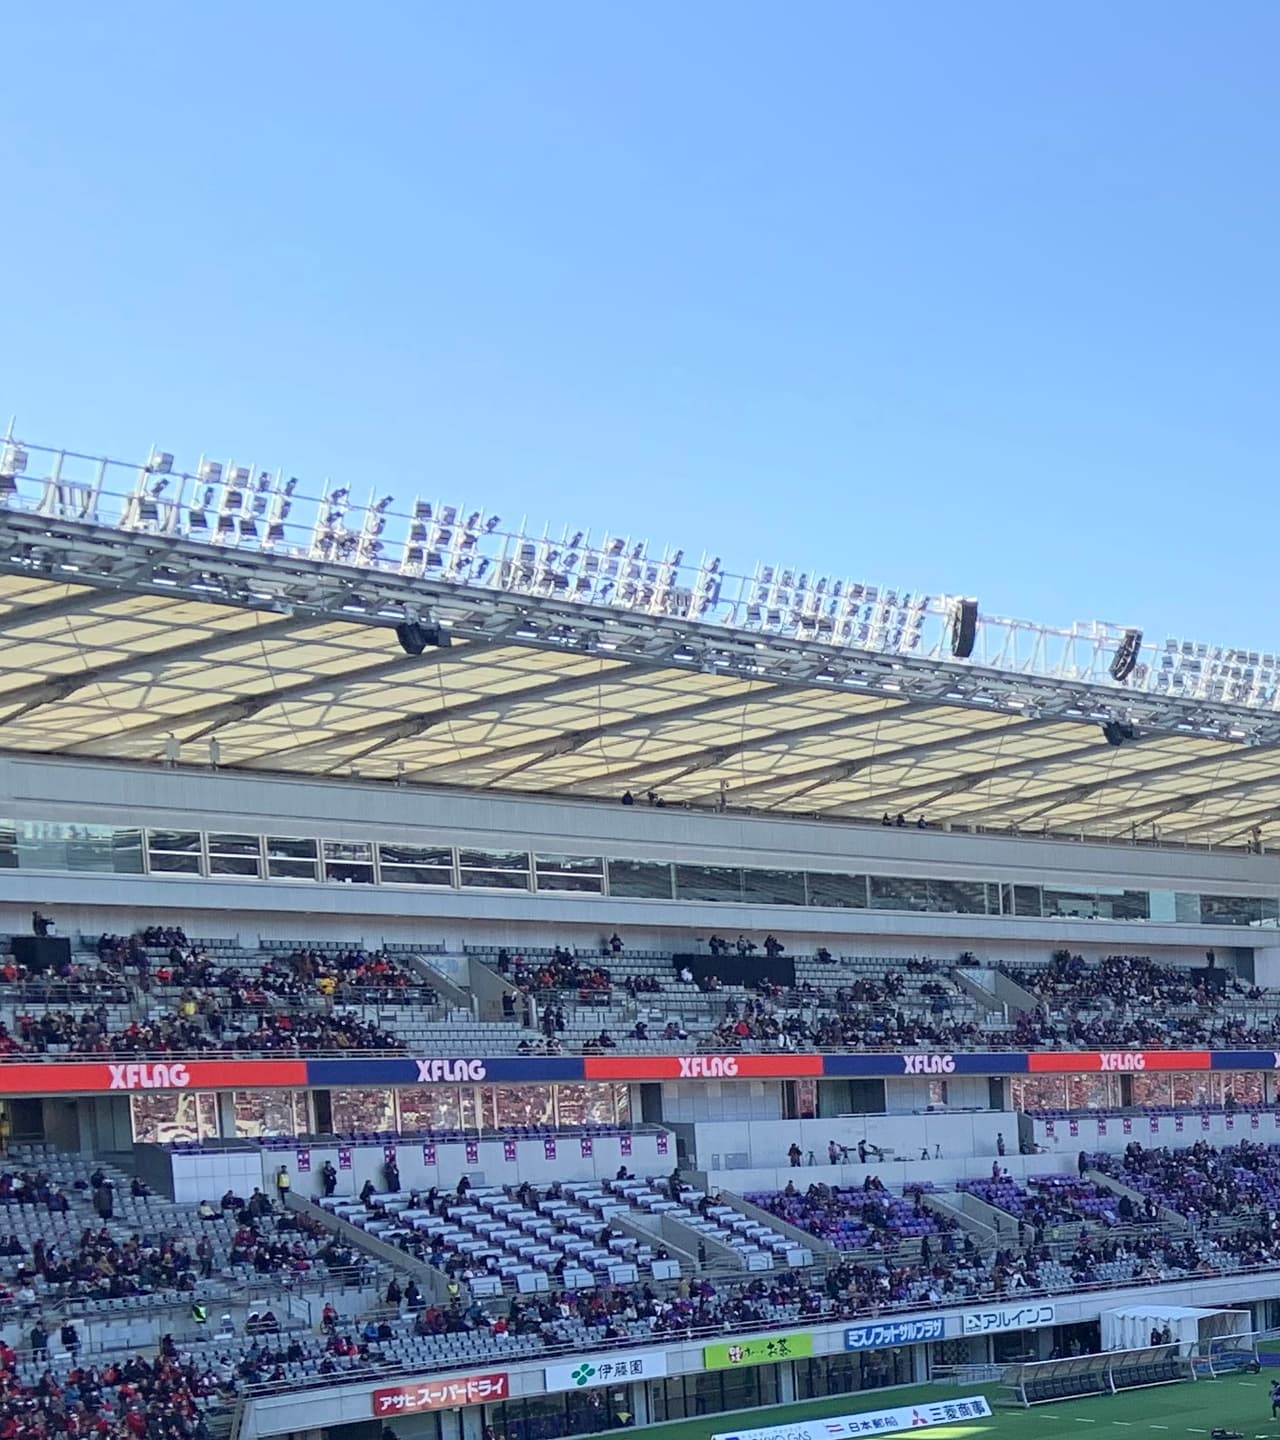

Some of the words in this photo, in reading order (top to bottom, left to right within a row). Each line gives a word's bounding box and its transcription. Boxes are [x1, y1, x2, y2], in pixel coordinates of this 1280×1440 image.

[416, 1060, 486, 1082] XFLAG
[679, 1057, 738, 1077] XFLAG
[903, 1055, 955, 1074] XFLAG
[1099, 1053, 1145, 1071] XFLAG
[109, 1064, 190, 1088] XFLAG
[983, 1306, 1054, 1332] アルインコ
[848, 1318, 943, 1348] ミズノフットサルプラザ
[598, 1359, 643, 1380] 伊藤園
[929, 1400, 987, 1422] 三菱商事
[848, 1415, 899, 1433] 日本郵船
